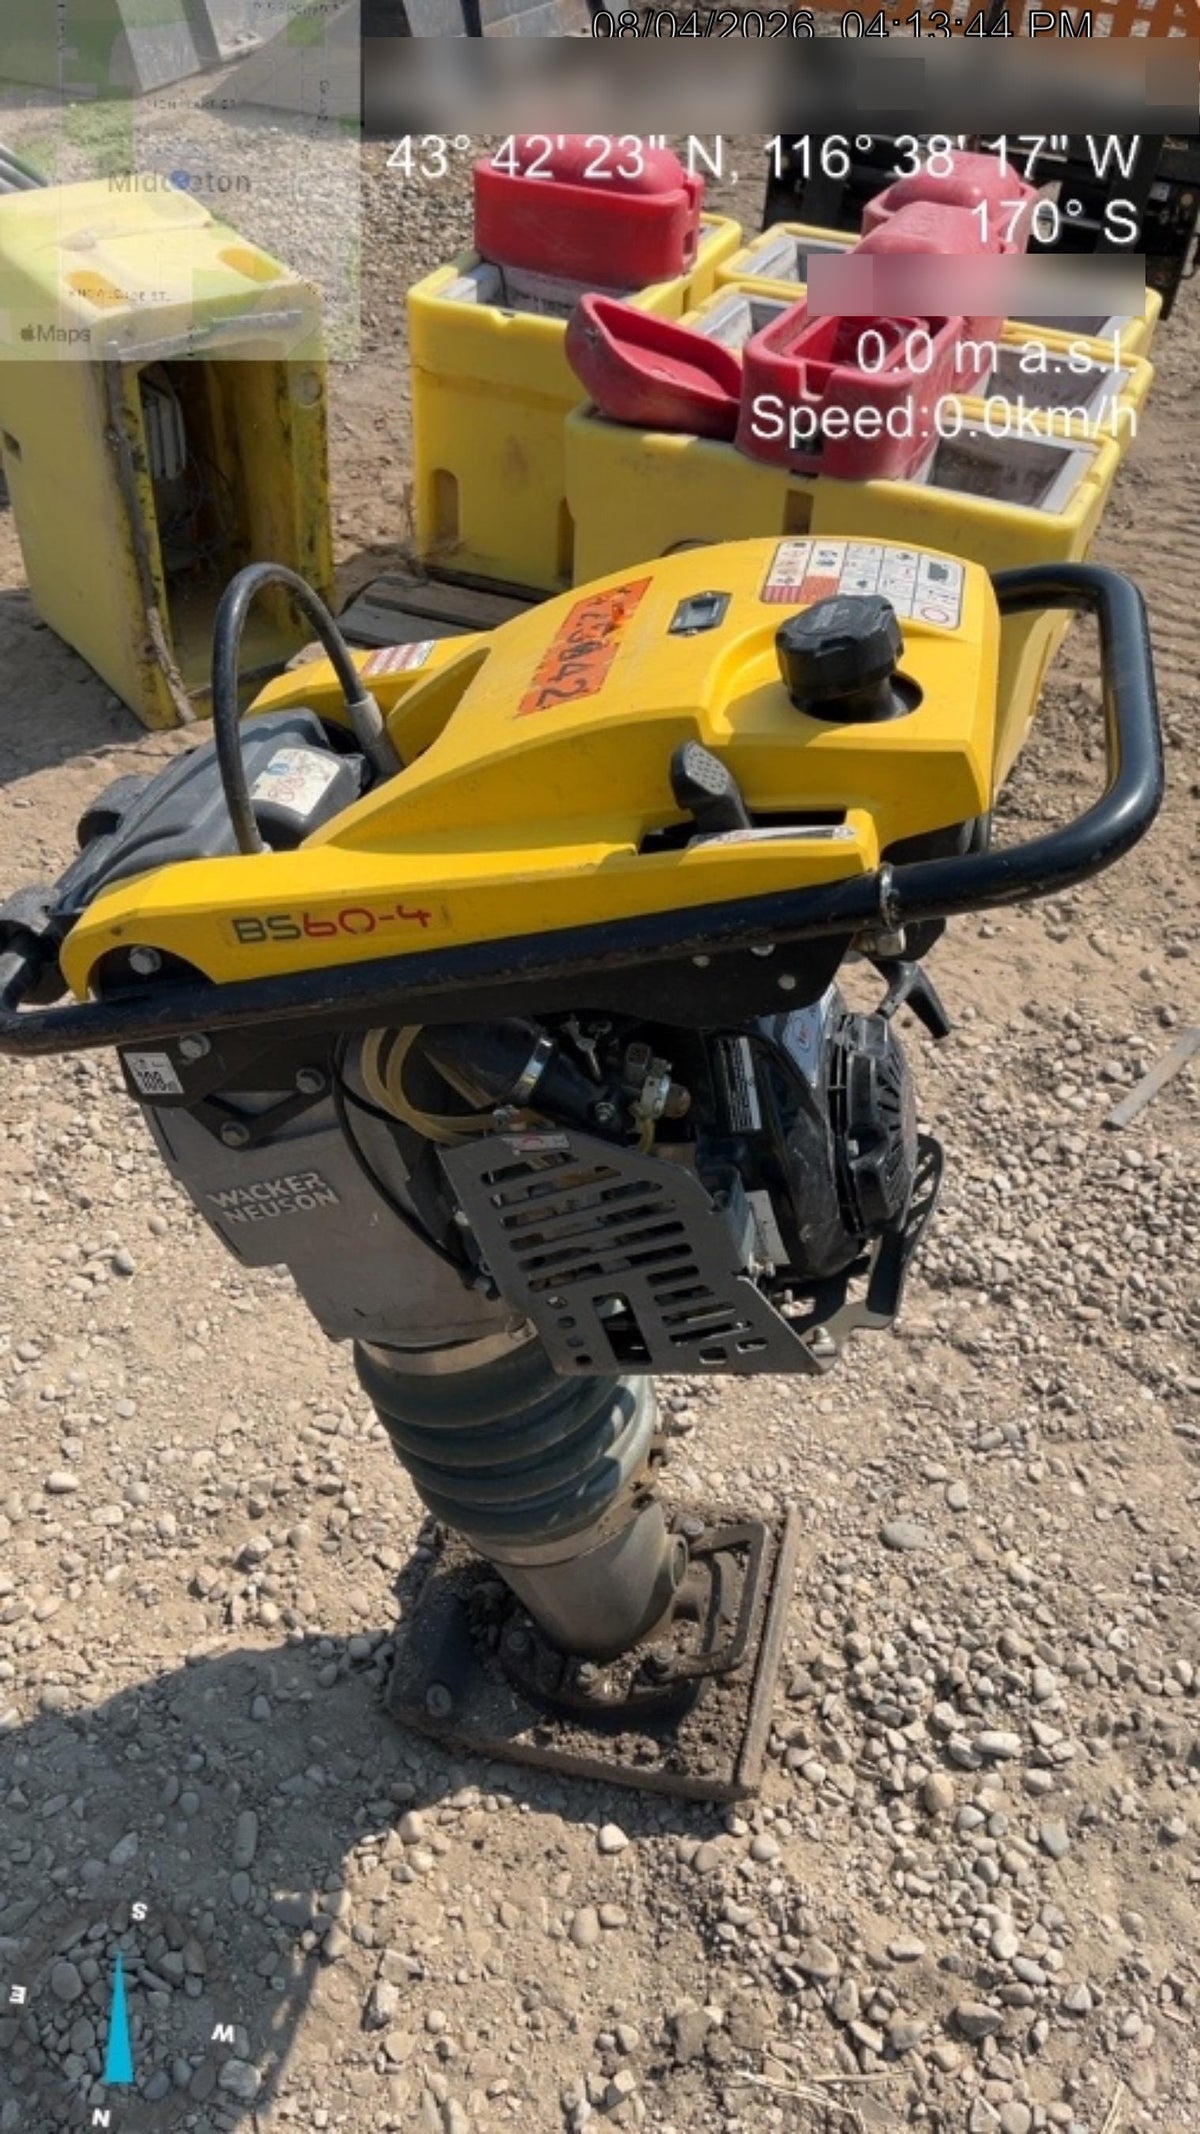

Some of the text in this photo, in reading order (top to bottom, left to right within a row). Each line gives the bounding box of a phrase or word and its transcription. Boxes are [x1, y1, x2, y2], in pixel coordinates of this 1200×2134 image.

[231, 904, 432, 944] BS60-4
[205, 1172, 326, 1208] WACKER
[221, 1187, 340, 1223] NEUSON
